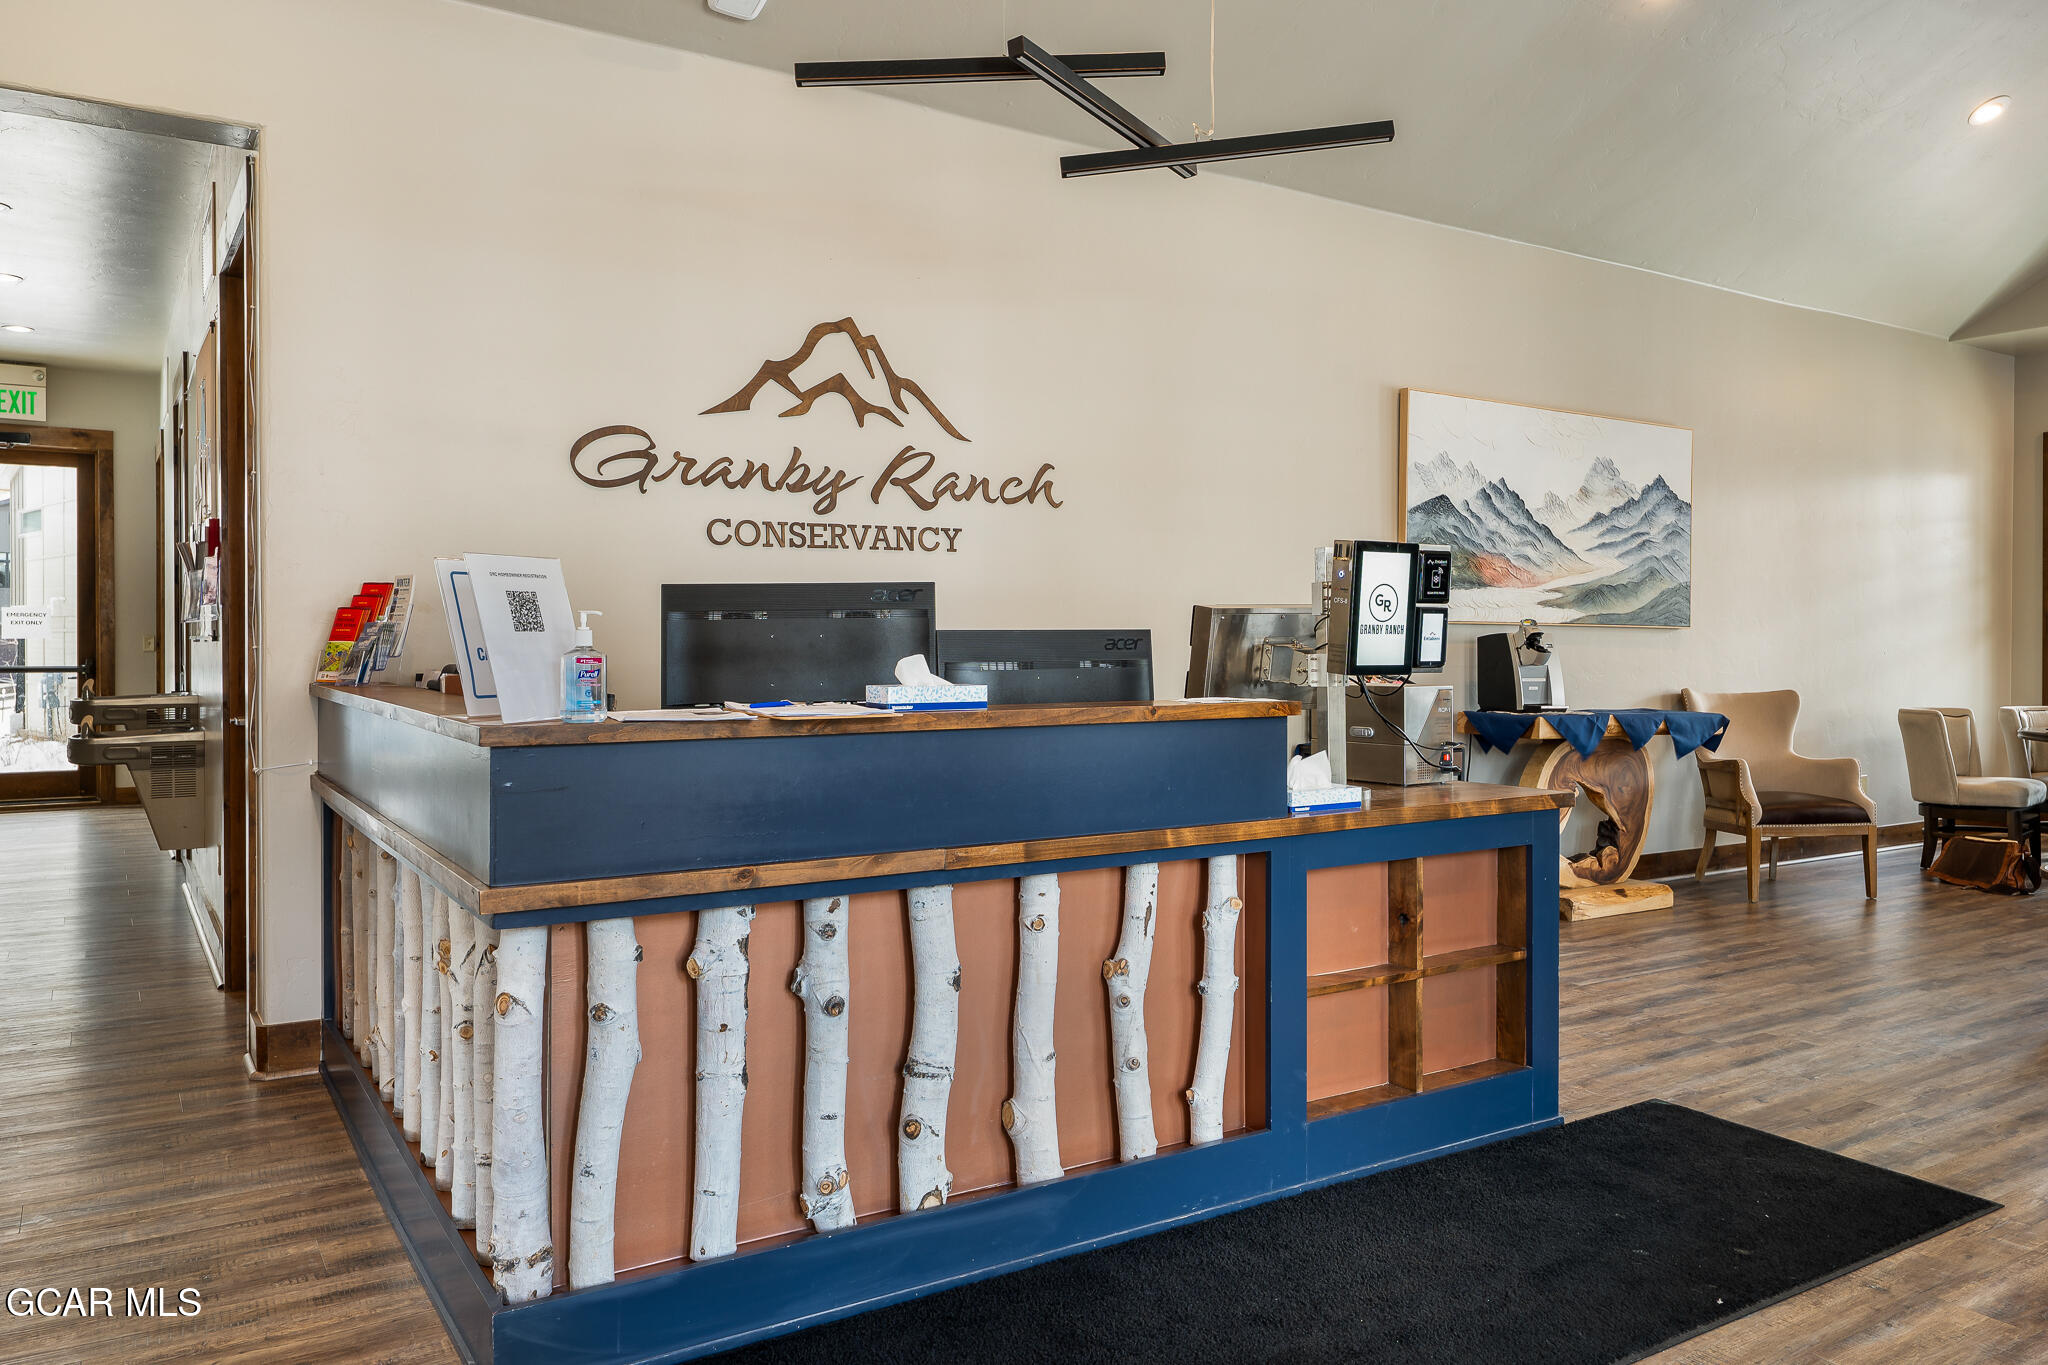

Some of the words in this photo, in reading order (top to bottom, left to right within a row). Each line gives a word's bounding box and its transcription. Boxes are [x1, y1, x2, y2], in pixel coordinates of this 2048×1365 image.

[0, 389, 38, 416] EXIT
[569, 424, 864, 516] Granby
[870, 444, 1064, 511] Ranch
[705, 518, 963, 553] CONSERVANCY
[1359, 624, 1384, 635] GRANBY
[1385, 624, 1405, 635] RANCH
[1104, 638, 1143, 651] acer
